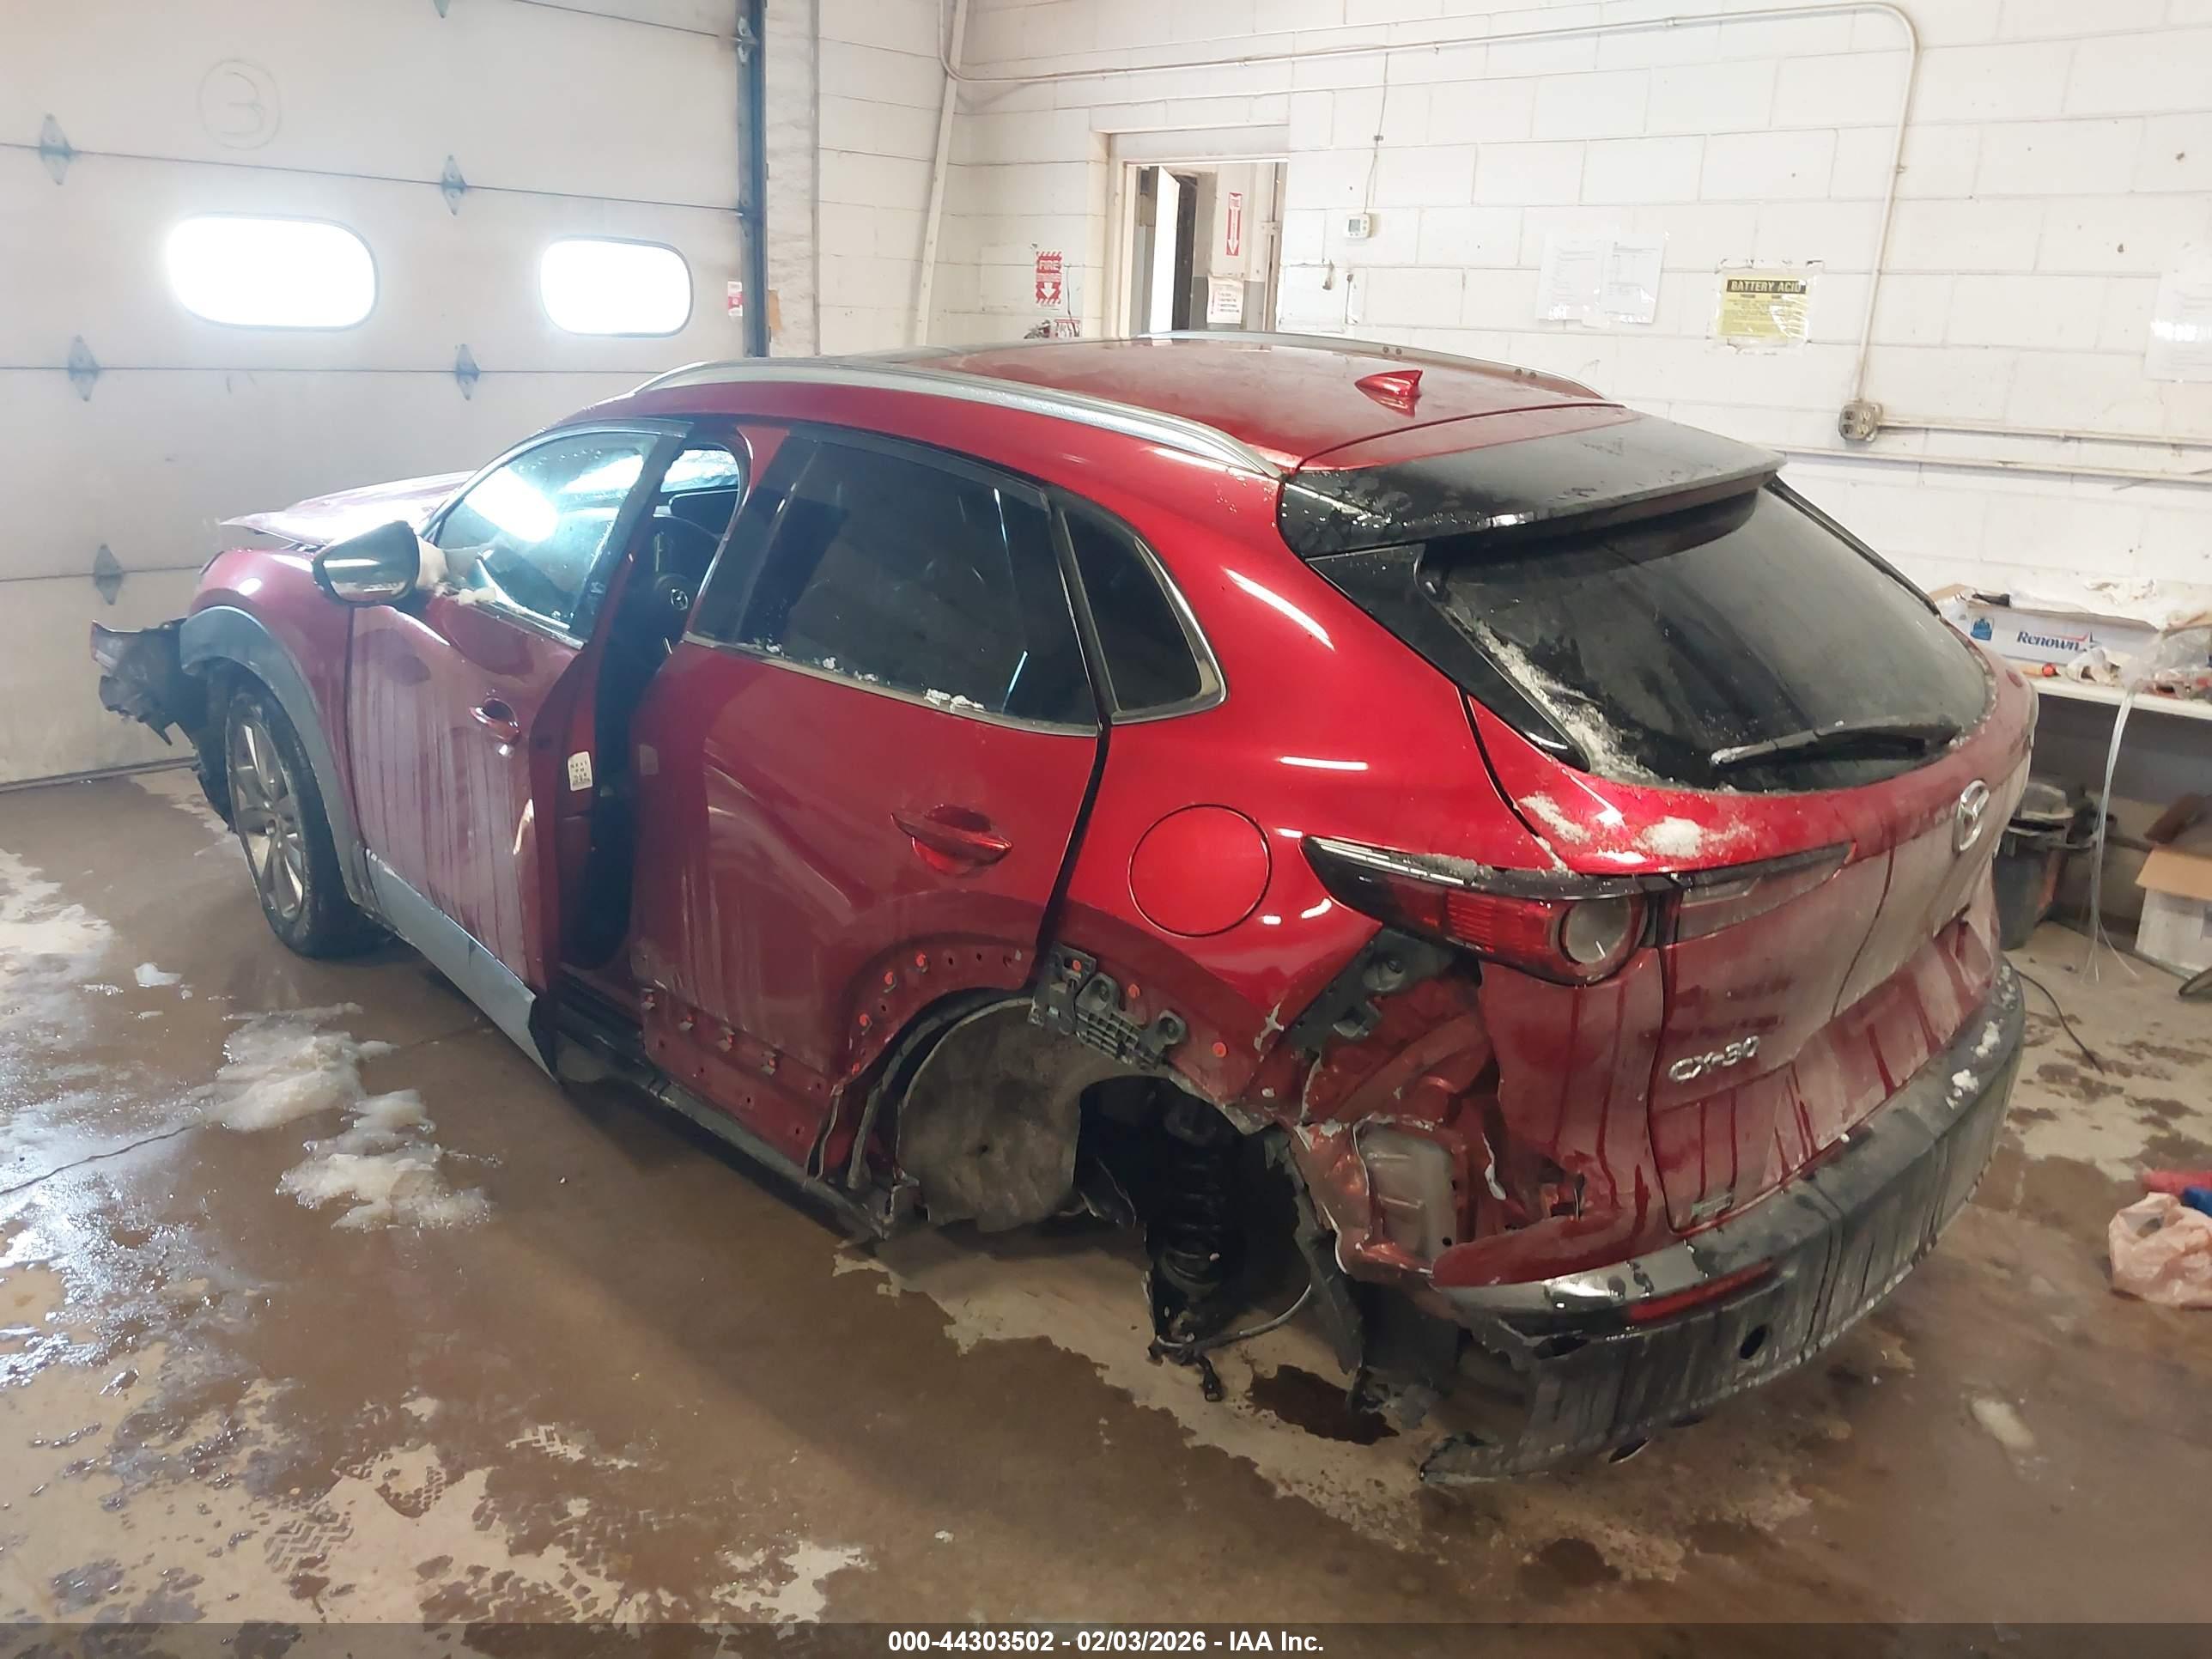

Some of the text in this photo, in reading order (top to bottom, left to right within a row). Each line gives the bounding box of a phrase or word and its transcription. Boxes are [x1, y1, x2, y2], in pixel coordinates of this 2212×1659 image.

[1039, 259, 1060, 270] FIRE
[1730, 280, 1802, 293] BATTERY ACID
[2016, 630, 2081, 653] Renown
[1668, 1035, 1760, 1083] CX-30
